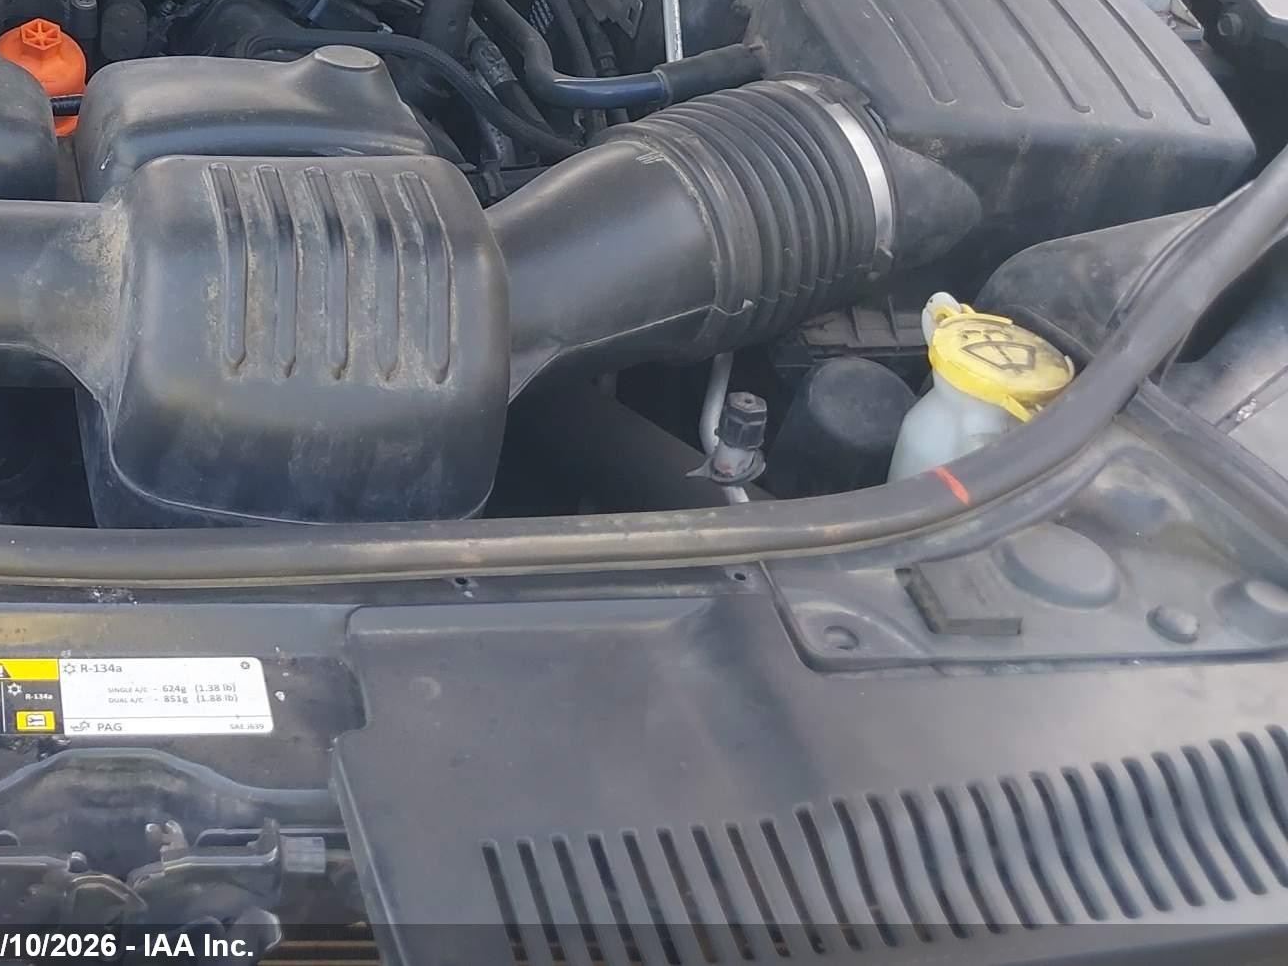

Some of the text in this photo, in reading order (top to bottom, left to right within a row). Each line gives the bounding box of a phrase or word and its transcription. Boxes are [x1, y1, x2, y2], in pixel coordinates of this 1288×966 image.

[80, 663, 123, 674] R-134a
[162, 684, 188, 695] 624g
[195, 683, 221, 693] (1.38
[223, 682, 237, 693] lb)
[24, 693, 54, 701] R-134a
[163, 695, 189, 705] 851g
[225, 693, 239, 703] lb)
[97, 721, 123, 732] PAG
